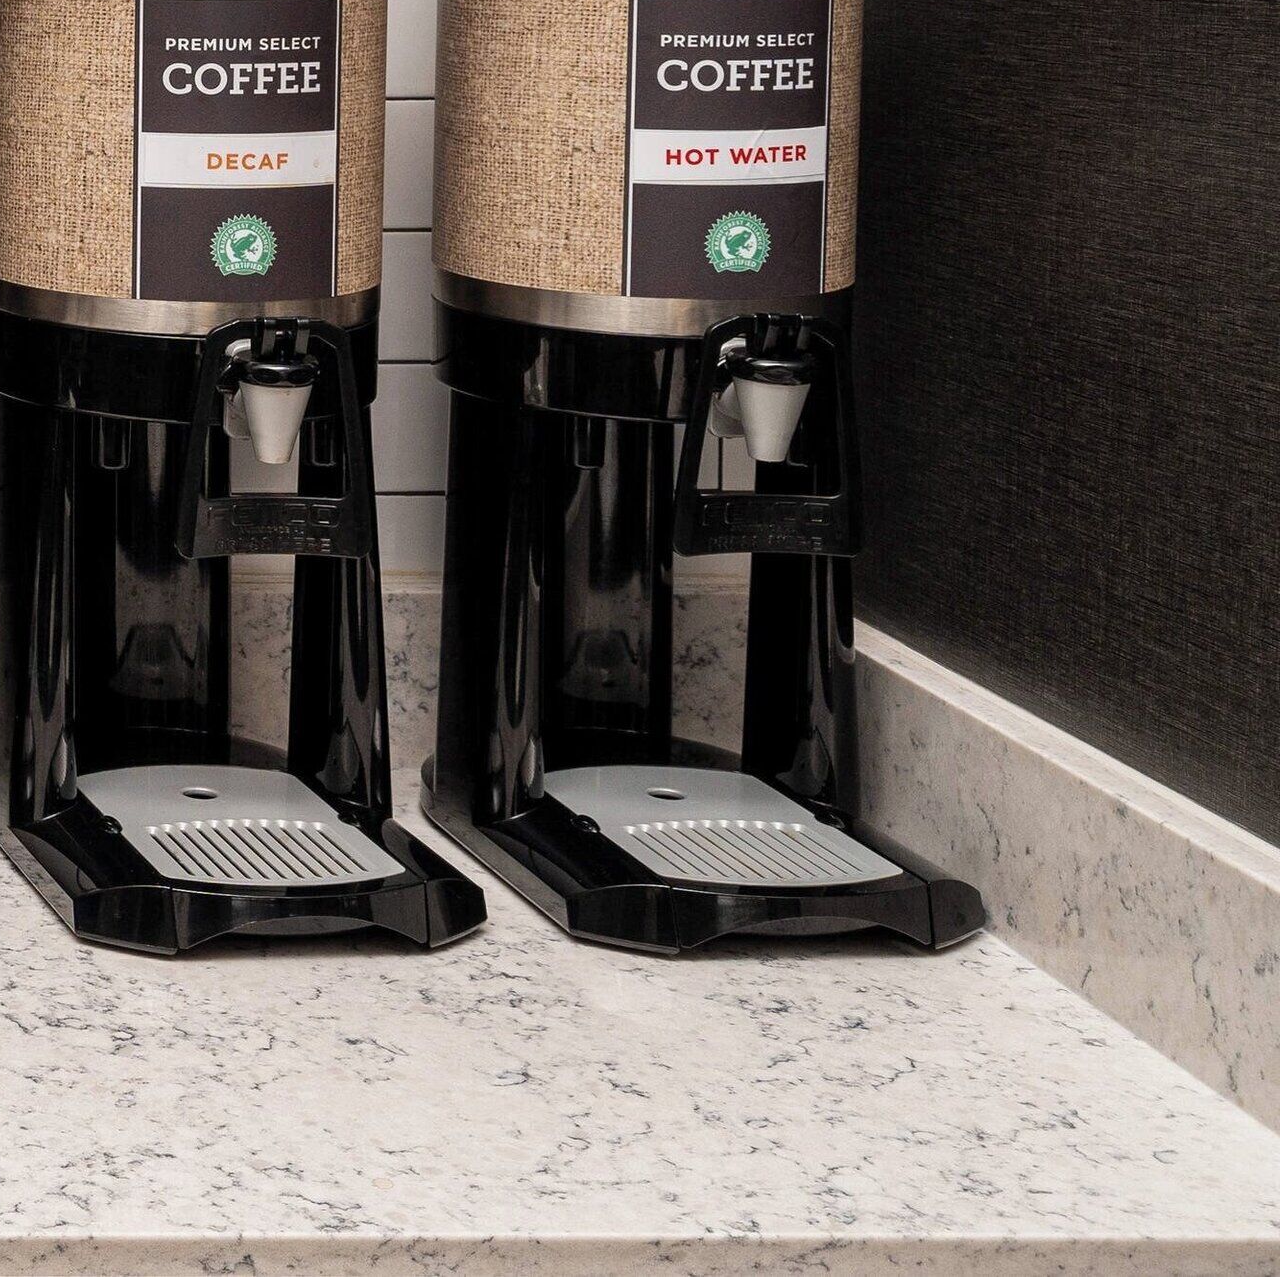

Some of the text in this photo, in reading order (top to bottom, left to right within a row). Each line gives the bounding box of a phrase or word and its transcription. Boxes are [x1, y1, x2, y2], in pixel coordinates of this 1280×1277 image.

[165, 36, 321, 52] PREMIUM SELECT
[660, 33, 816, 49] PREMIUM SELECT
[162, 63, 321, 95] COFFEE
[656, 58, 814, 92] COFFEE
[206, 152, 288, 170] DECAF
[665, 145, 807, 166] HOT WATER
[220, 223, 269, 253] RAINFOREST ALLIANCE
[225, 262, 263, 271] CERTIFIED
[720, 258, 757, 268] CERTIFIED
